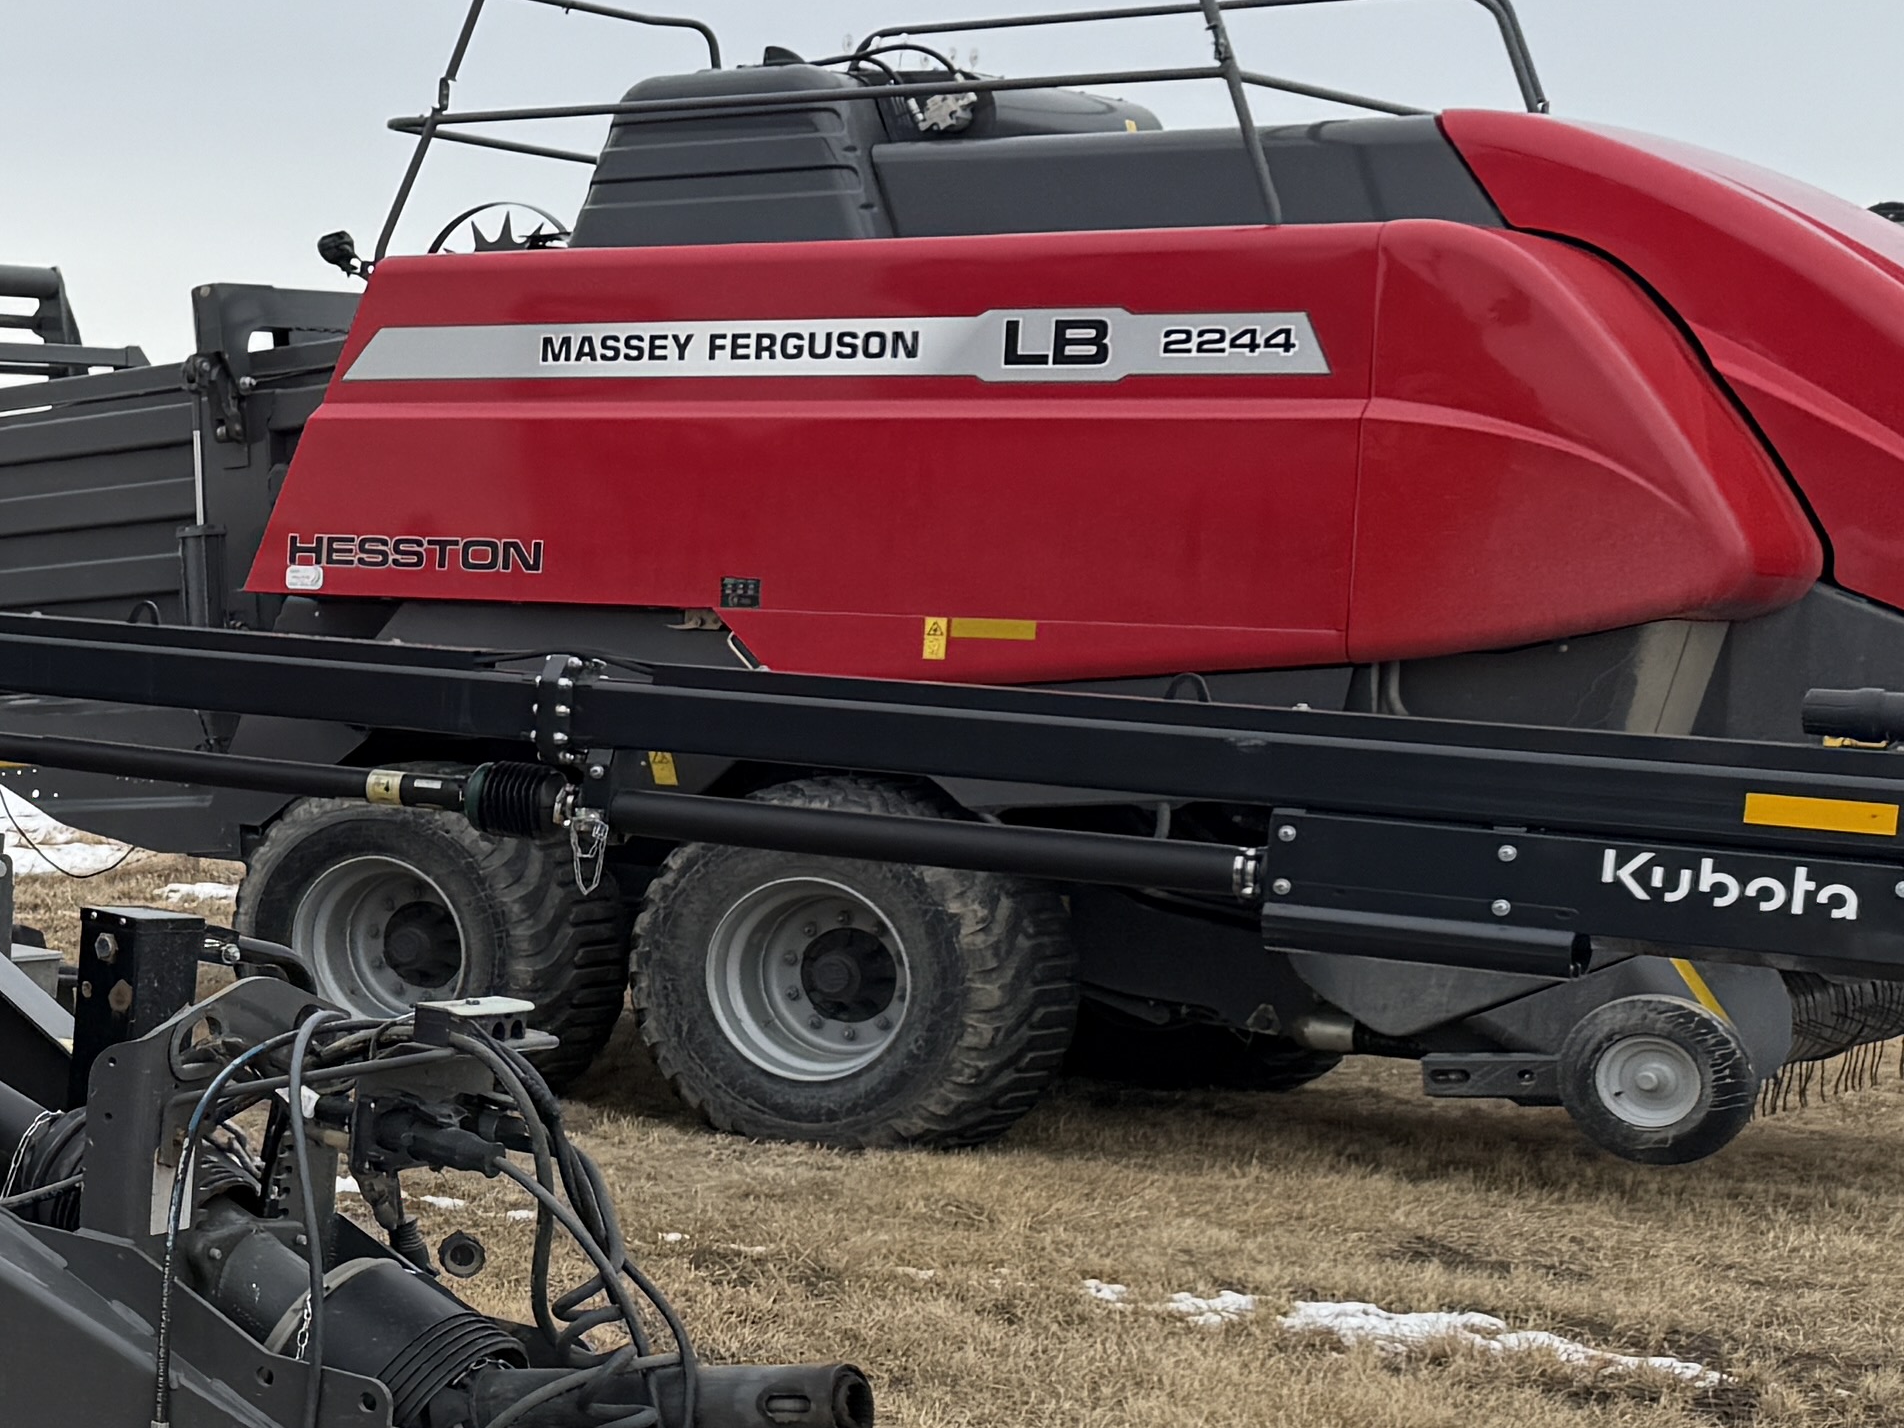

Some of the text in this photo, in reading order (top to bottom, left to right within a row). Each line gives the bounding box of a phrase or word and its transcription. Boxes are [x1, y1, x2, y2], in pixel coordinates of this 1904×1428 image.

[540, 318, 1298, 367] MASSEY FERGUSON LB 2244
[287, 533, 544, 573] HESSTON
[1600, 848, 1859, 920] Kubota
